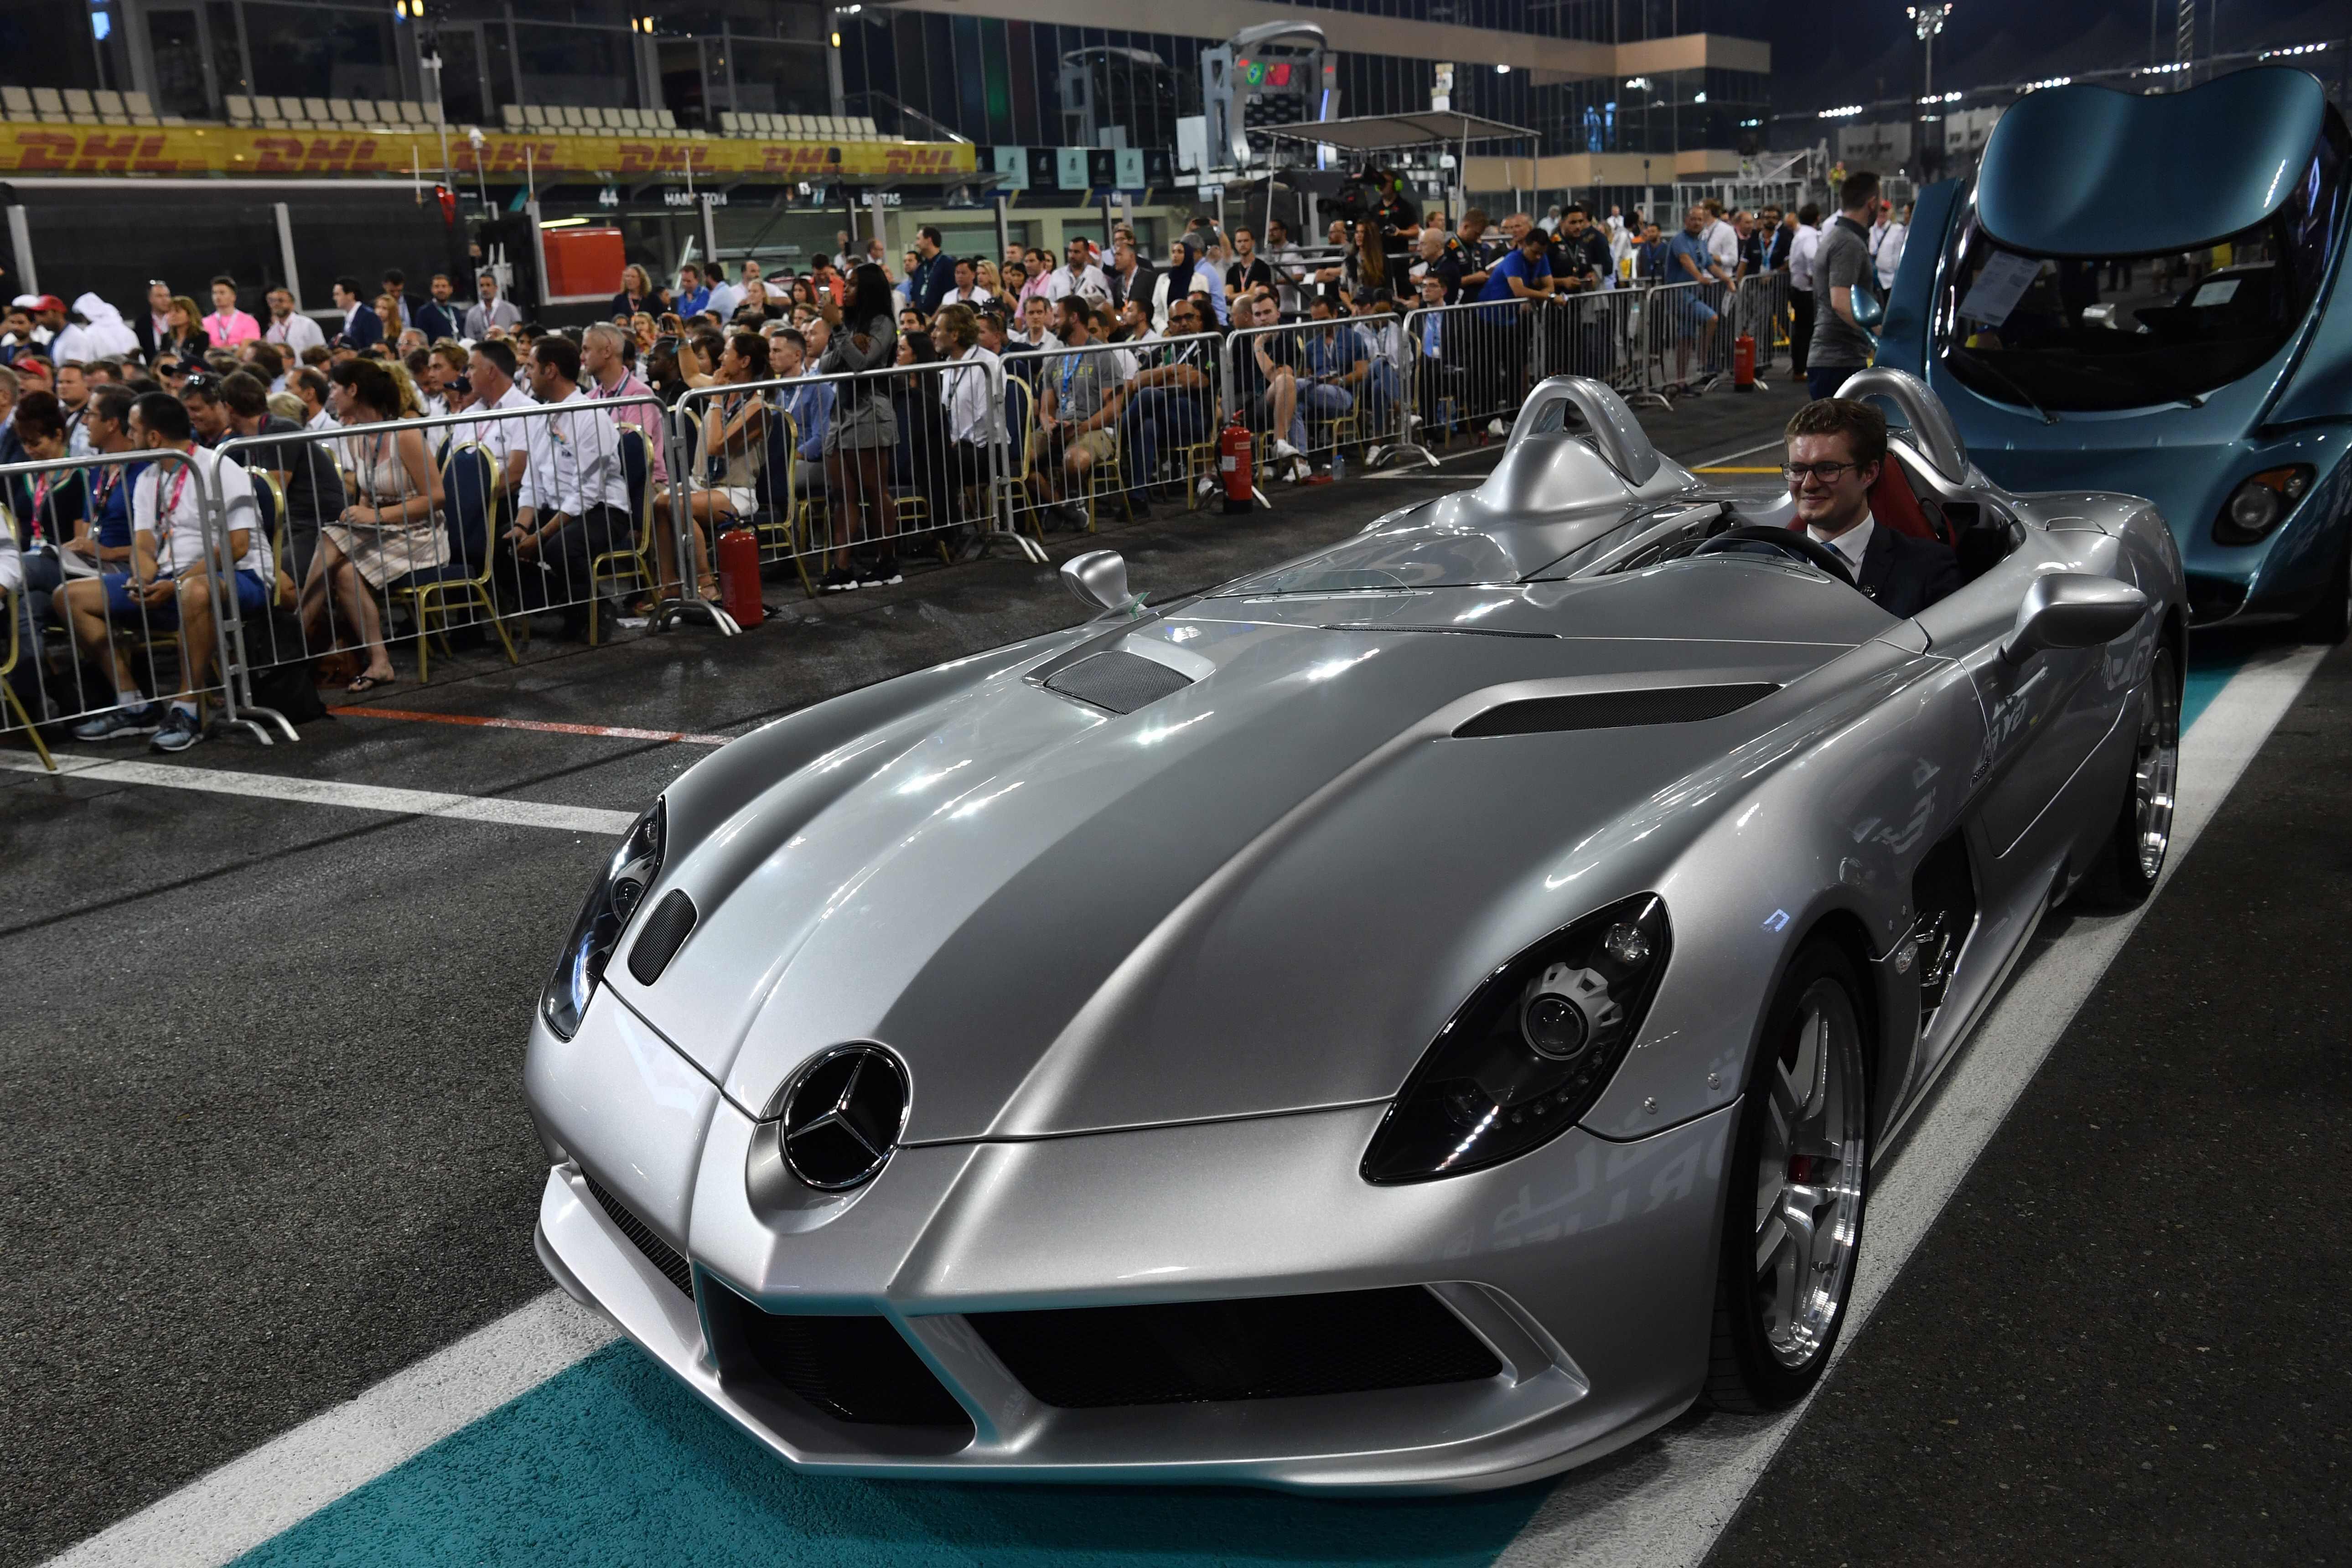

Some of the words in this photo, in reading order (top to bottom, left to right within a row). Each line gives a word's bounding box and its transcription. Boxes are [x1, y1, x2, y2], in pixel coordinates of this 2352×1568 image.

[16, 132, 178, 171] DHL
[254, 138, 388, 171] DHL
[451, 141, 565, 171] DHL
[619, 145, 715, 172] DHL
[886, 150, 957, 174] DHL
[599, 188, 619, 206] 44
[664, 192, 728, 205] HAMTON
